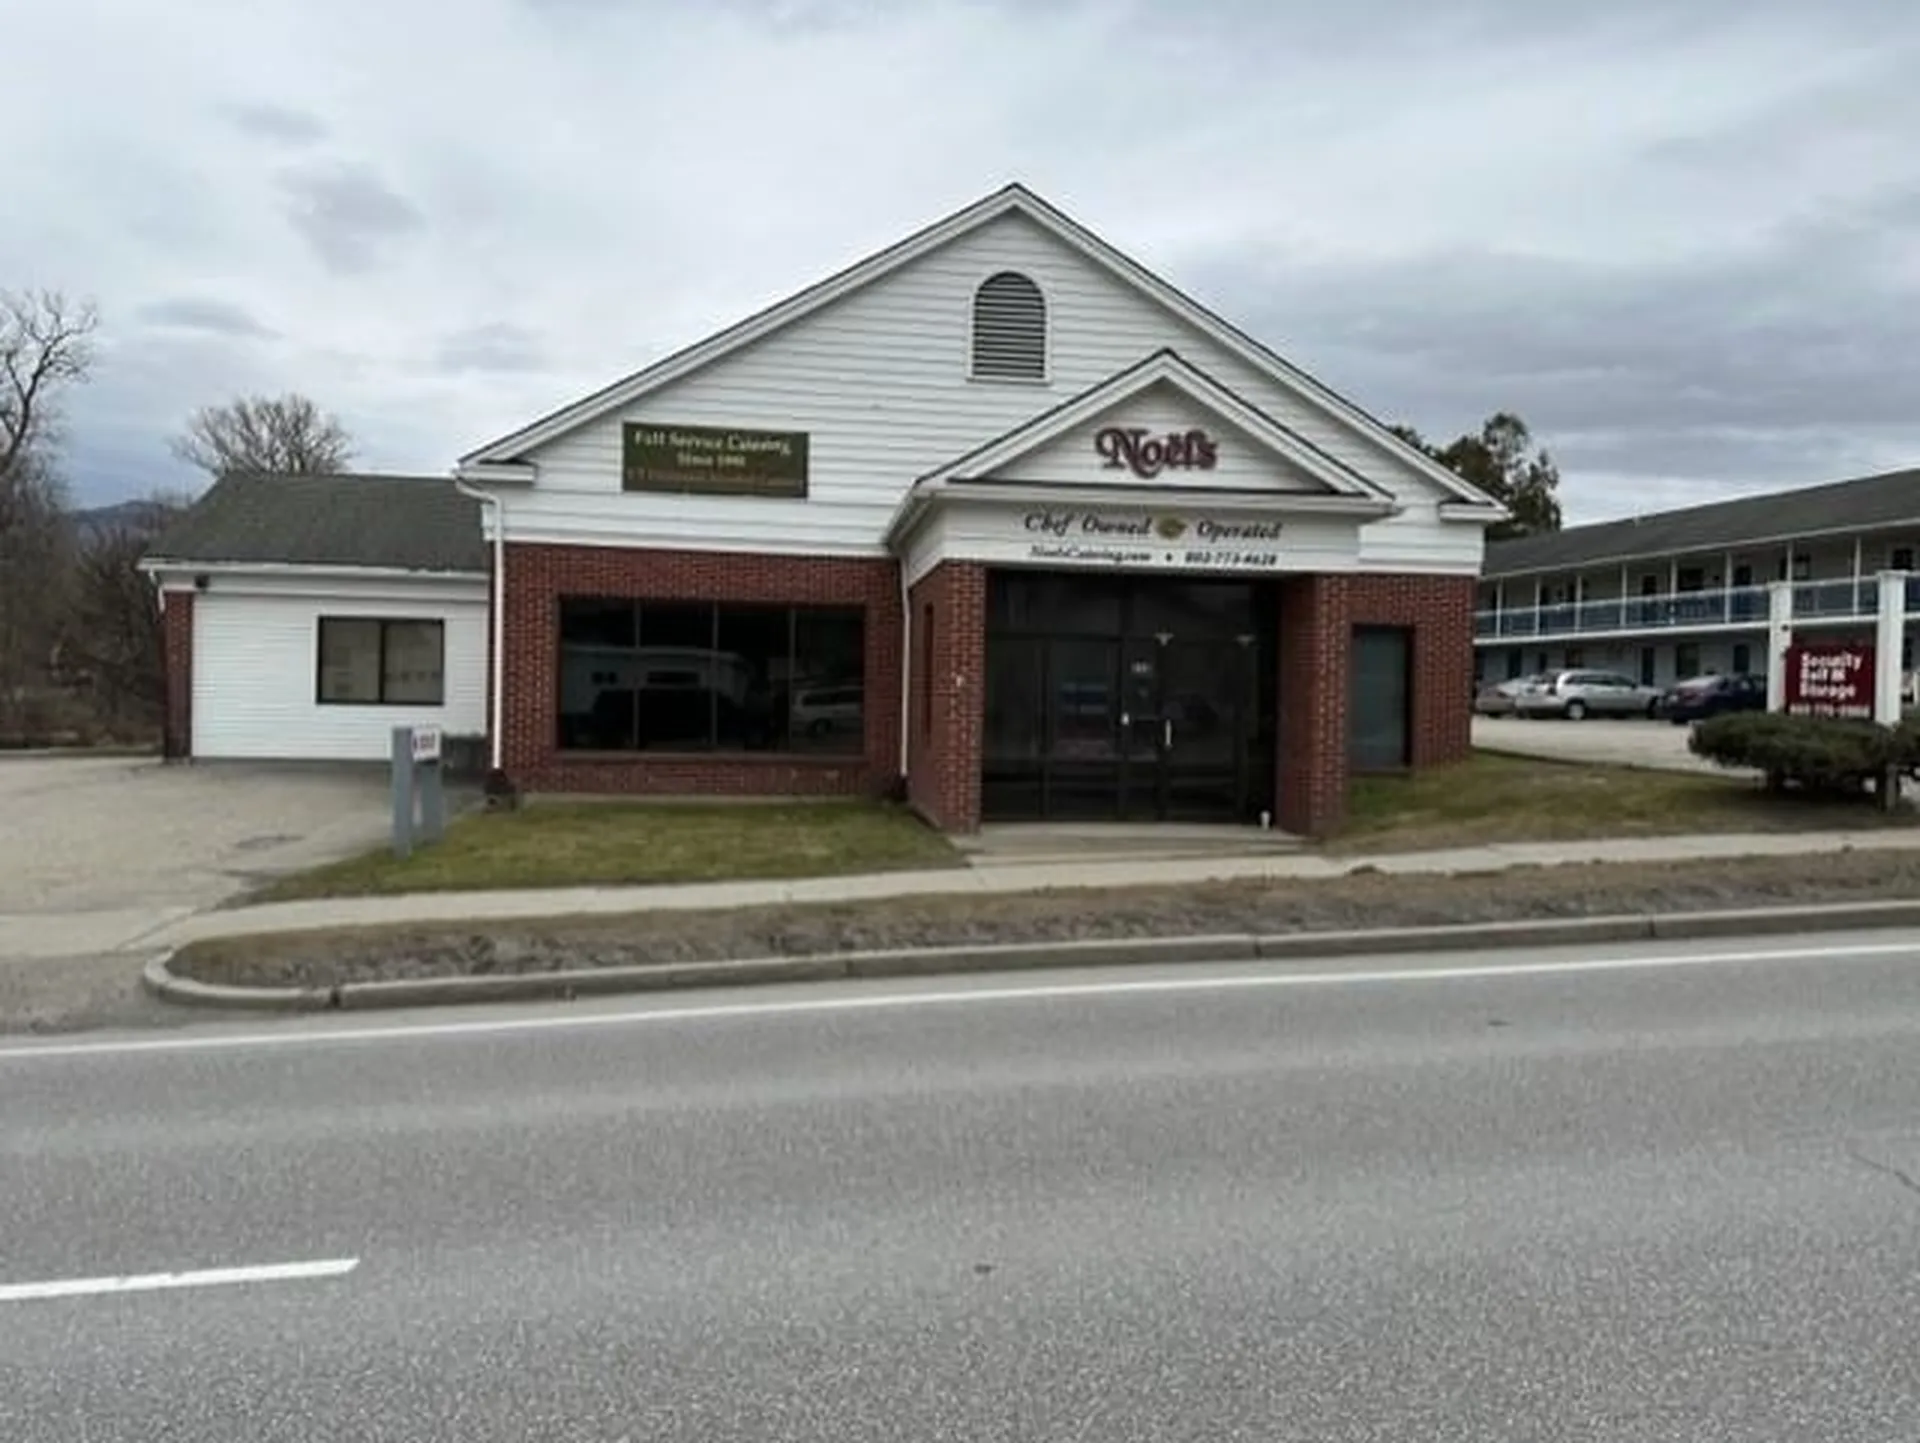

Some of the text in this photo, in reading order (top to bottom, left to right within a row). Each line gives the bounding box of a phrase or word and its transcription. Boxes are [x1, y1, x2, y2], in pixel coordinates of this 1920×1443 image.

[634, 430, 792, 457] Full Service Catering
[1024, 511, 1283, 544] Chef Owned Operated
[1800, 651, 1863, 672] Security
[1799, 683, 1857, 701] Storage
